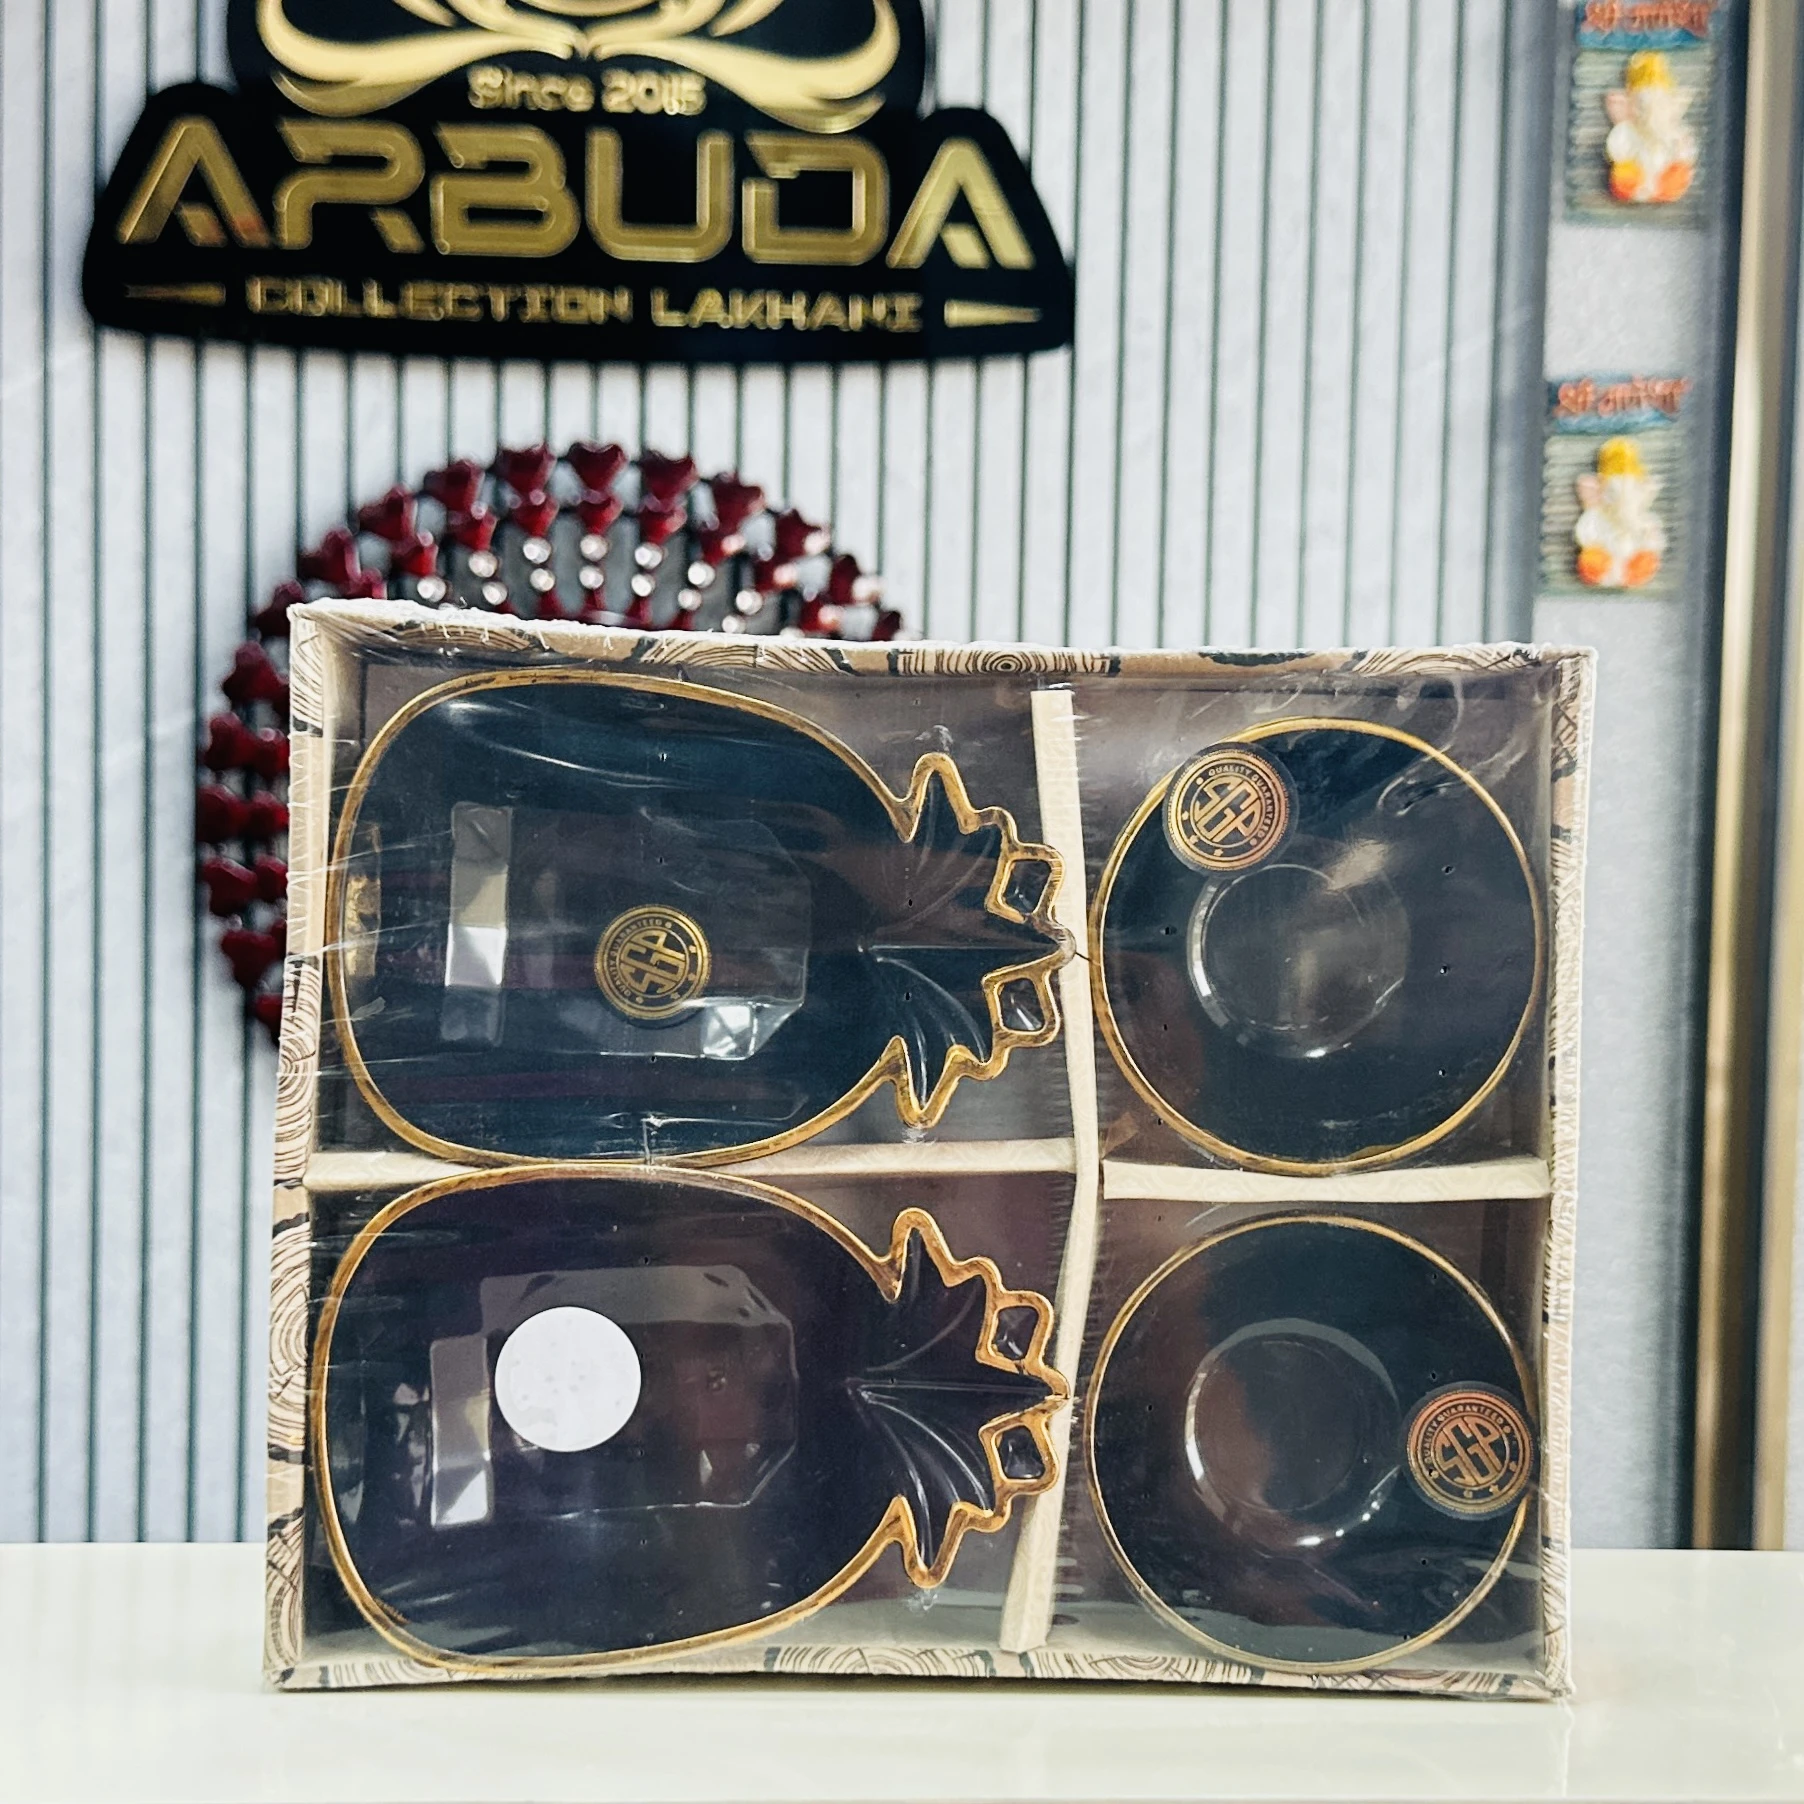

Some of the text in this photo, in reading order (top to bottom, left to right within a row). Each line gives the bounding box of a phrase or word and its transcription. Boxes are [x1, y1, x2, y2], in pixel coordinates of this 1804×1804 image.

[467, 64, 708, 116] Since 2015
[117, 113, 1036, 271] ARBUDA
[246, 275, 924, 333] COLLECTION LAKHANI
[1208, 764, 1274, 838] QUALITY GUARANTEED
[608, 959, 632, 997] QUALITY
[1422, 1420, 1439, 1464] QUALITY
